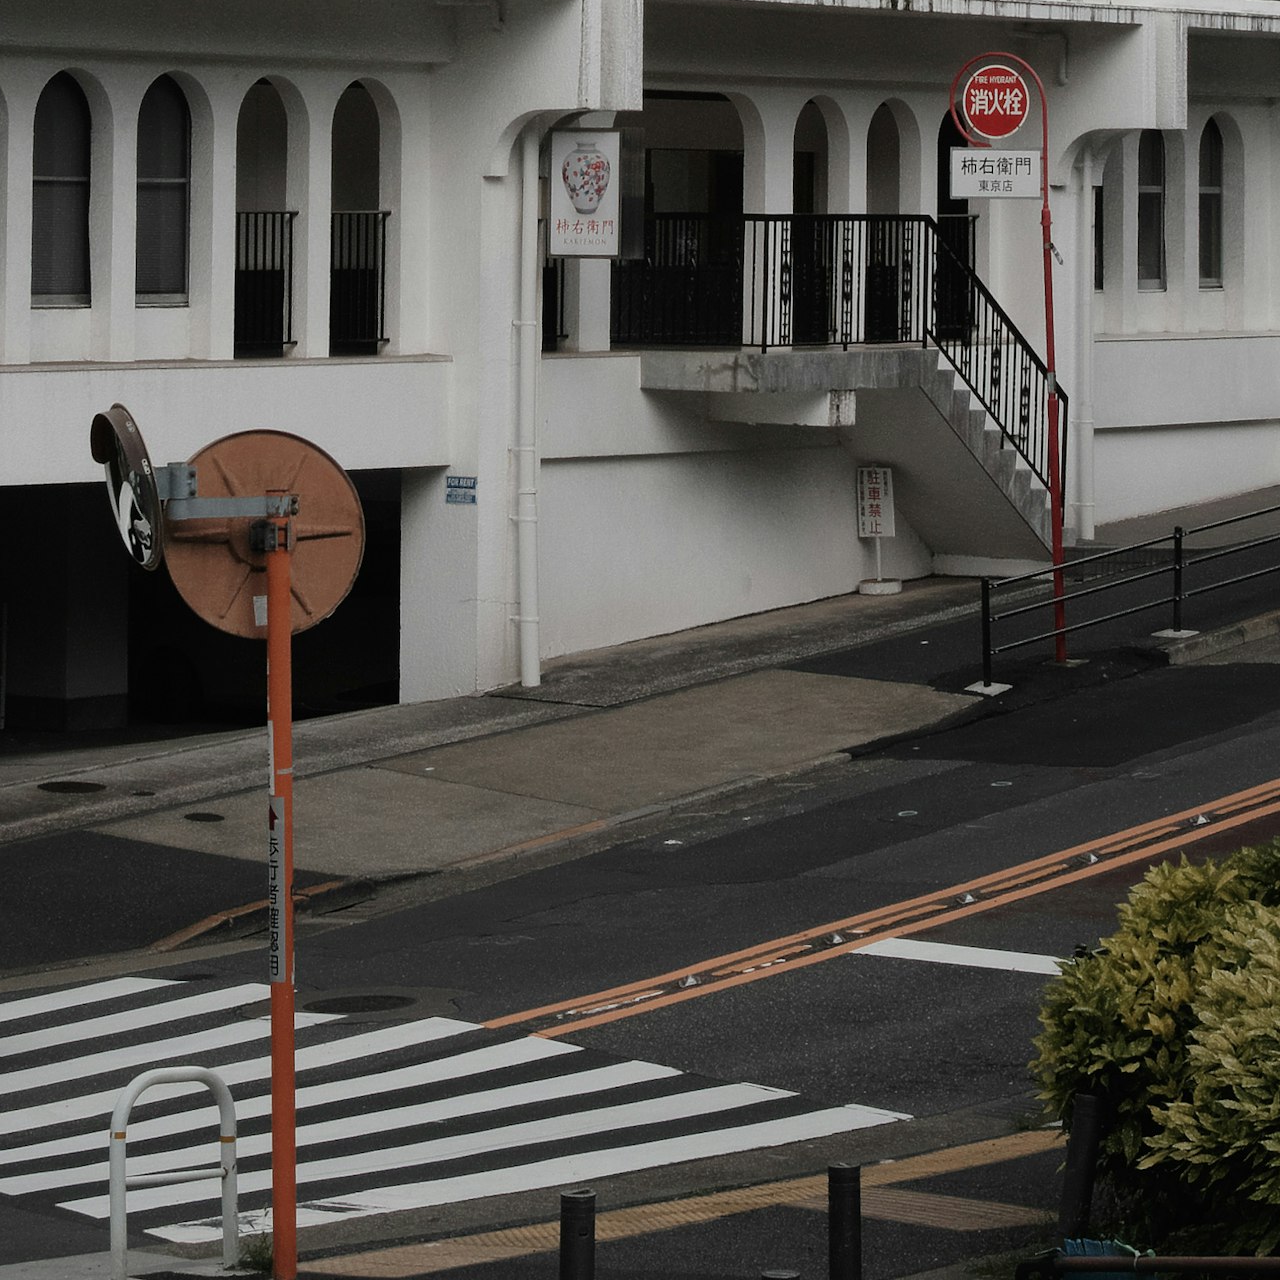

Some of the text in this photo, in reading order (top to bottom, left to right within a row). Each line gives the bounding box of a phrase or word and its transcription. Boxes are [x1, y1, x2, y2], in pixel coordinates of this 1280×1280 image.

[974, 76, 1017, 84] FIRE HYDRANT
[970, 88, 1023, 116] 消火栓
[961, 157, 1032, 176] 柿右衛門
[978, 180, 1013, 192] 東京店
[556, 219, 614, 235] 柿右衛門
[448, 478, 474, 487] FOR RENT
[867, 470, 882, 534] 駐車禁止
